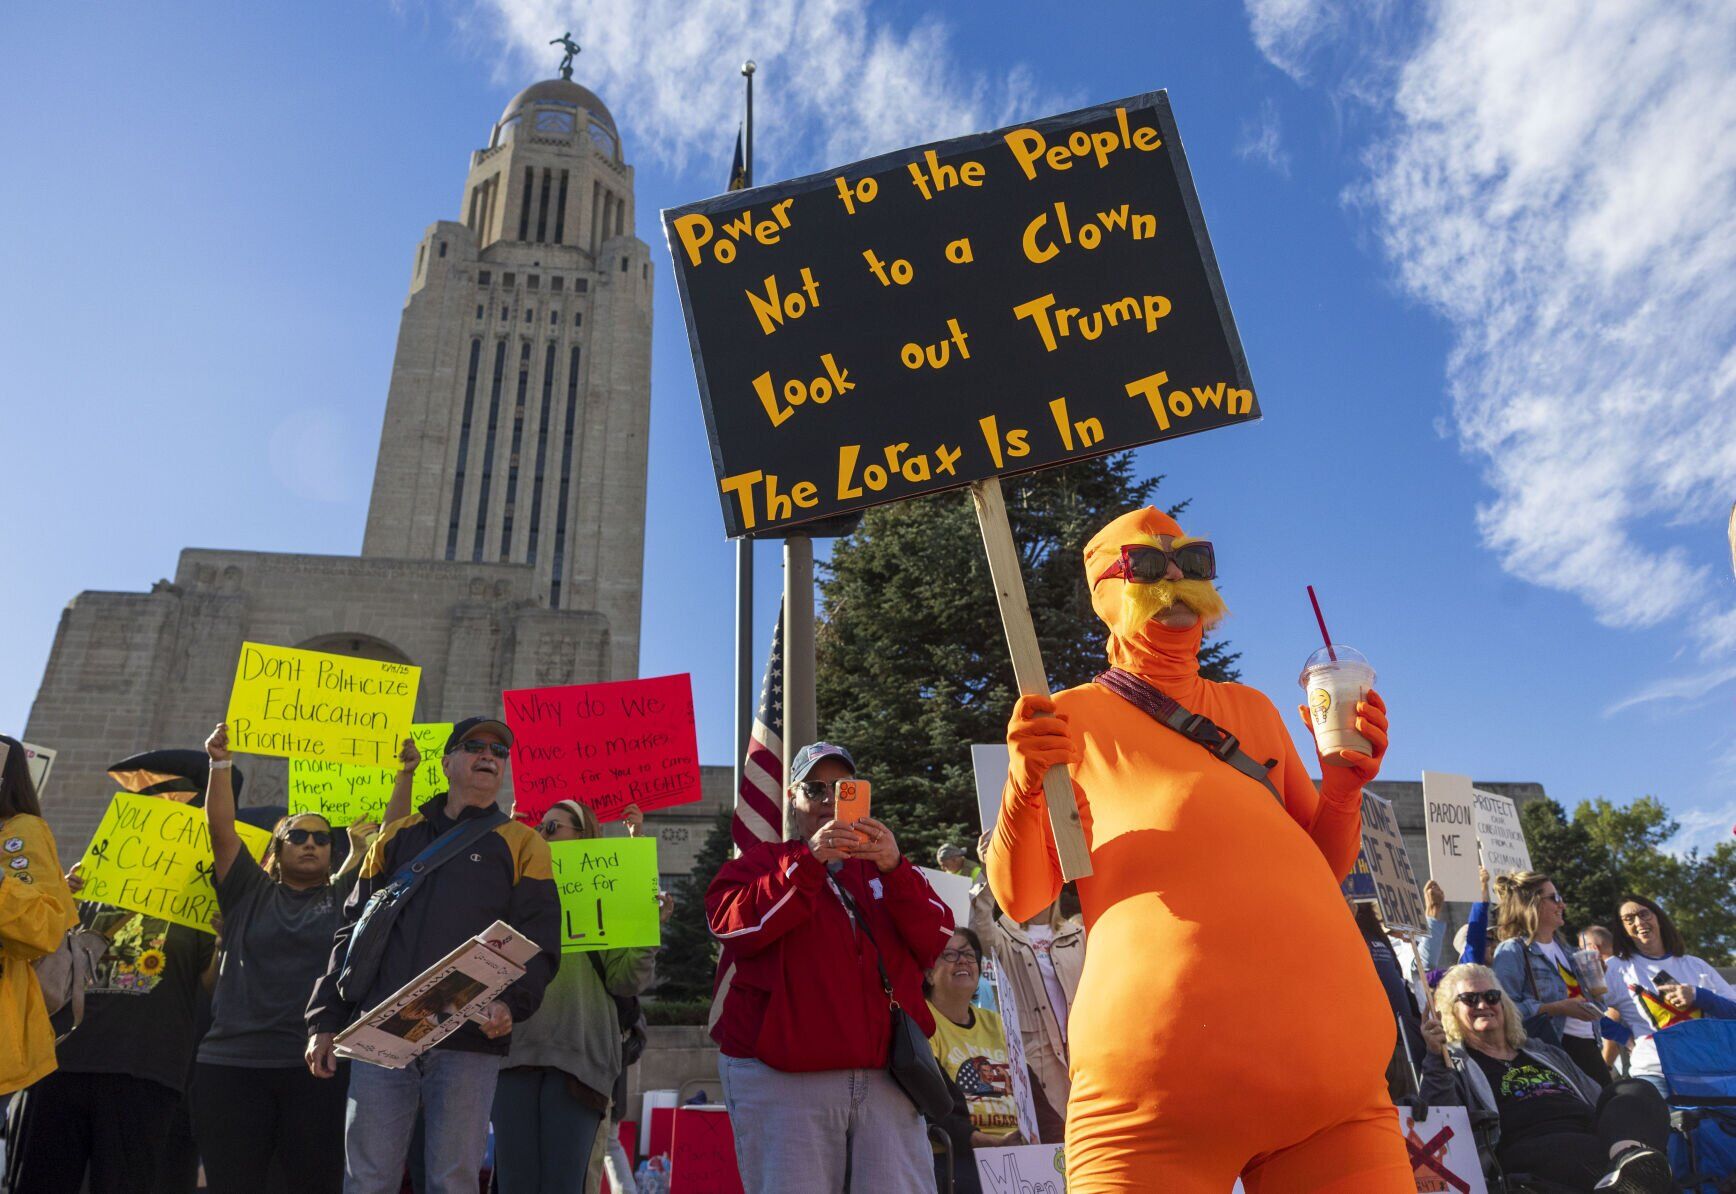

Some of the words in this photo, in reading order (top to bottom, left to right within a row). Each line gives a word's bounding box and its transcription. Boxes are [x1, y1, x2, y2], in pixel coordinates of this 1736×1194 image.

[674, 199, 793, 266] Power
[836, 177, 878, 214] to
[907, 150, 985, 200] the
[1004, 108, 1162, 180] People
[745, 268, 820, 335] Not
[862, 249, 913, 286] to
[945, 238, 973, 264] a
[1022, 202, 1156, 264] Clown
[752, 354, 856, 427] Look
[901, 319, 970, 369] out
[1013, 293, 1171, 352] Trump
[721, 470, 818, 528] The
[837, 443, 962, 500] Lorax
[979, 415, 1030, 468] Is
[1049, 397, 1104, 450] In
[1125, 371, 1254, 430] Town
[243, 648, 304, 681] Don't
[317, 659, 409, 696] Politicize
[263, 688, 388, 730] Education
[507, 694, 561, 727] Why
[576, 691, 605, 719] do
[233, 718, 325, 755] Prioritize
[516, 739, 566, 765] have
[577, 741, 597, 759] to
[293, 779, 333, 795] then
[346, 773, 371, 795] you
[628, 771, 695, 801] RIGHTS
[638, 764, 651, 774] to
[1429, 801, 1471, 826] PARDON
[1472, 794, 1513, 817] PROTECT
[579, 852, 619, 872] And
[1362, 833, 1383, 876] OF
[1384, 841, 1415, 885] THE
[1441, 834, 1462, 857] ME
[592, 874, 619, 892] for
[1377, 882, 1427, 931] BRAVE
[396, 965, 456, 1008] Crown
